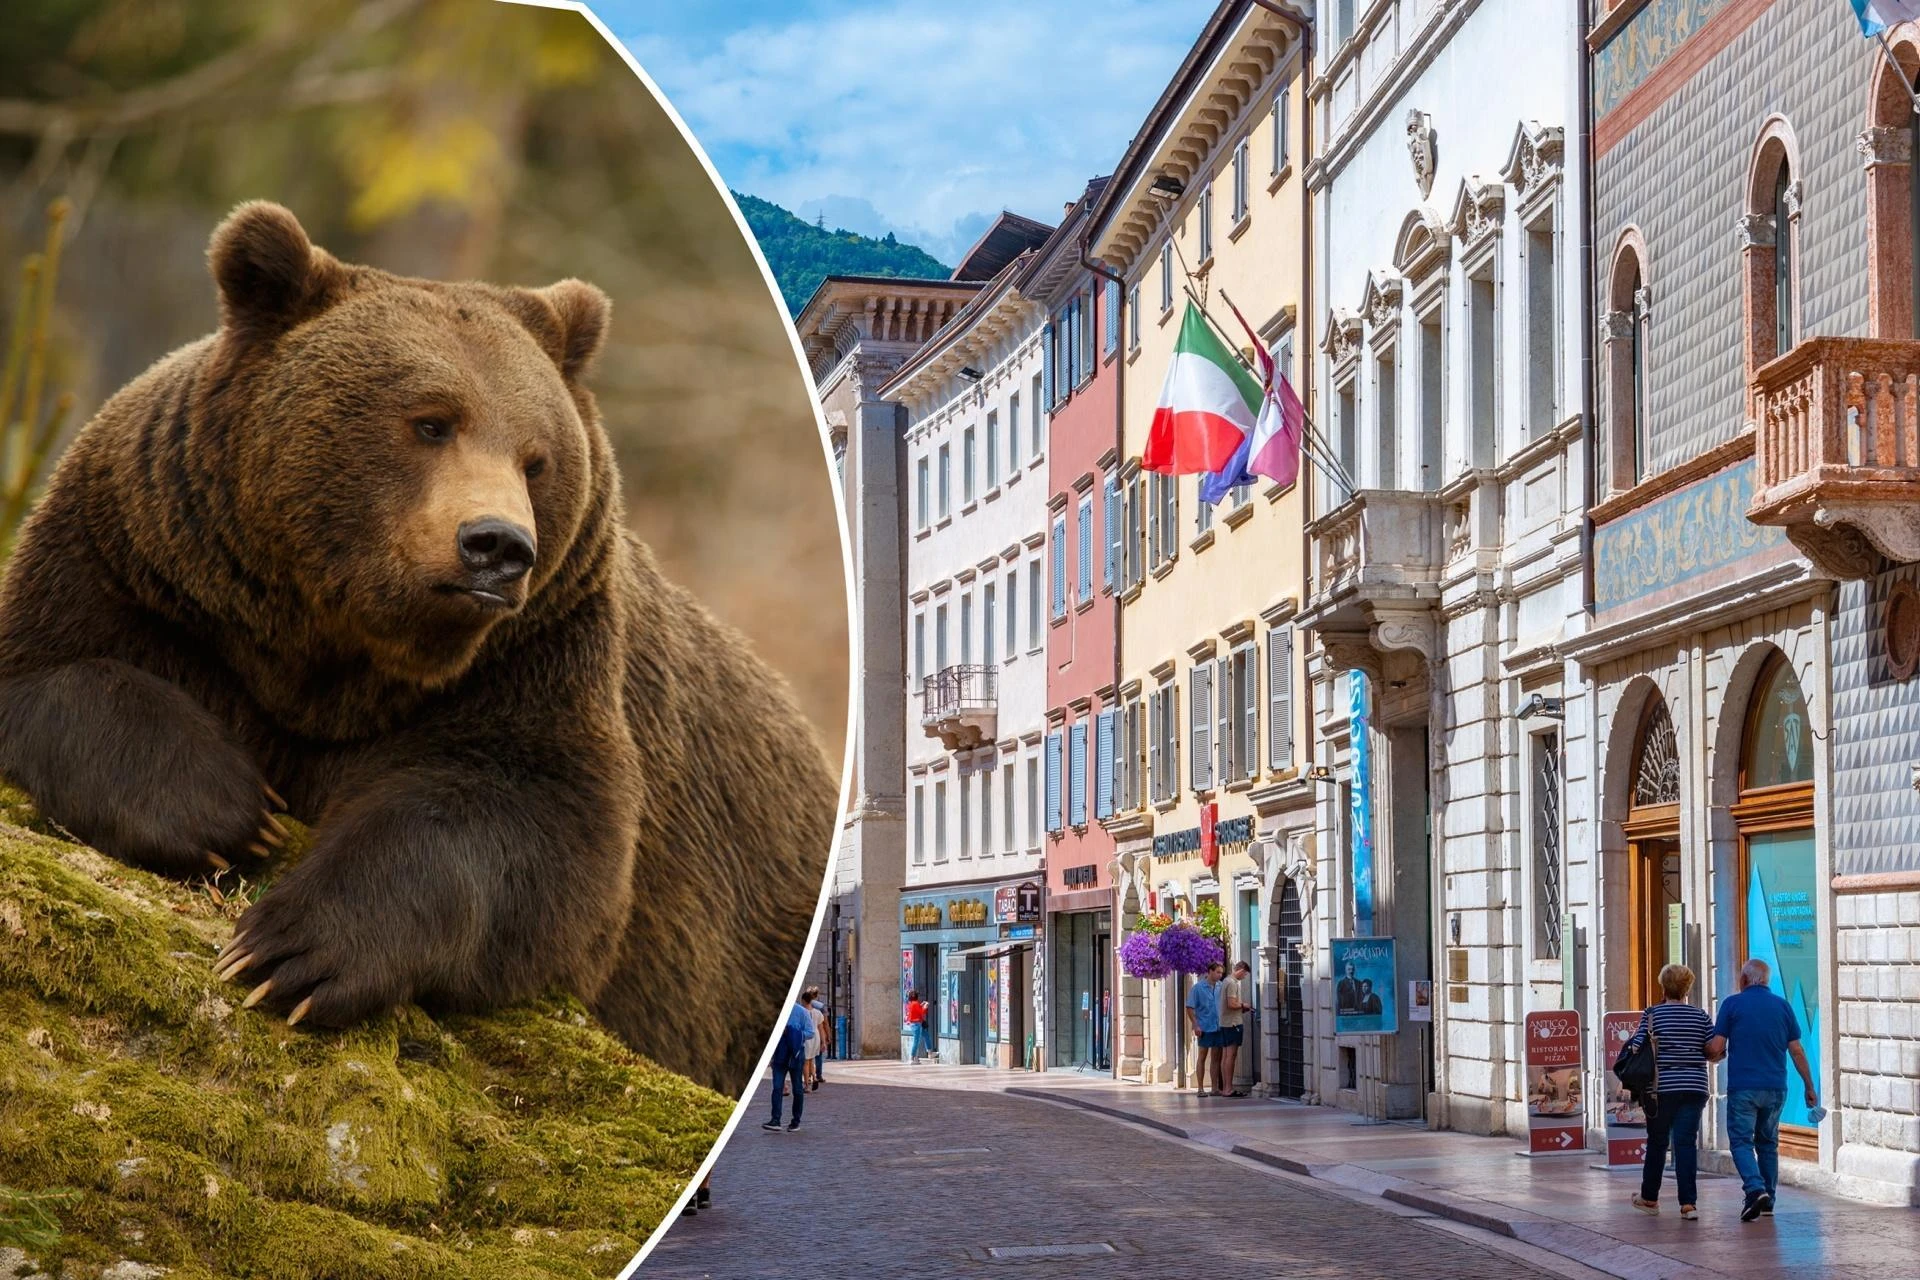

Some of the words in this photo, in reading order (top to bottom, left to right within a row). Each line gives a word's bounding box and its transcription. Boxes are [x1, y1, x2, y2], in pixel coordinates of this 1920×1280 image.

[997, 898, 1017, 913] TABAC
[1020, 889, 1037, 911] T
[1528, 1019, 1567, 1029] ANTICO
[1606, 1021, 1640, 1031] ANTIC
[1533, 1026, 1578, 1038] POZZO
[1611, 1029, 1636, 1041] POZ
